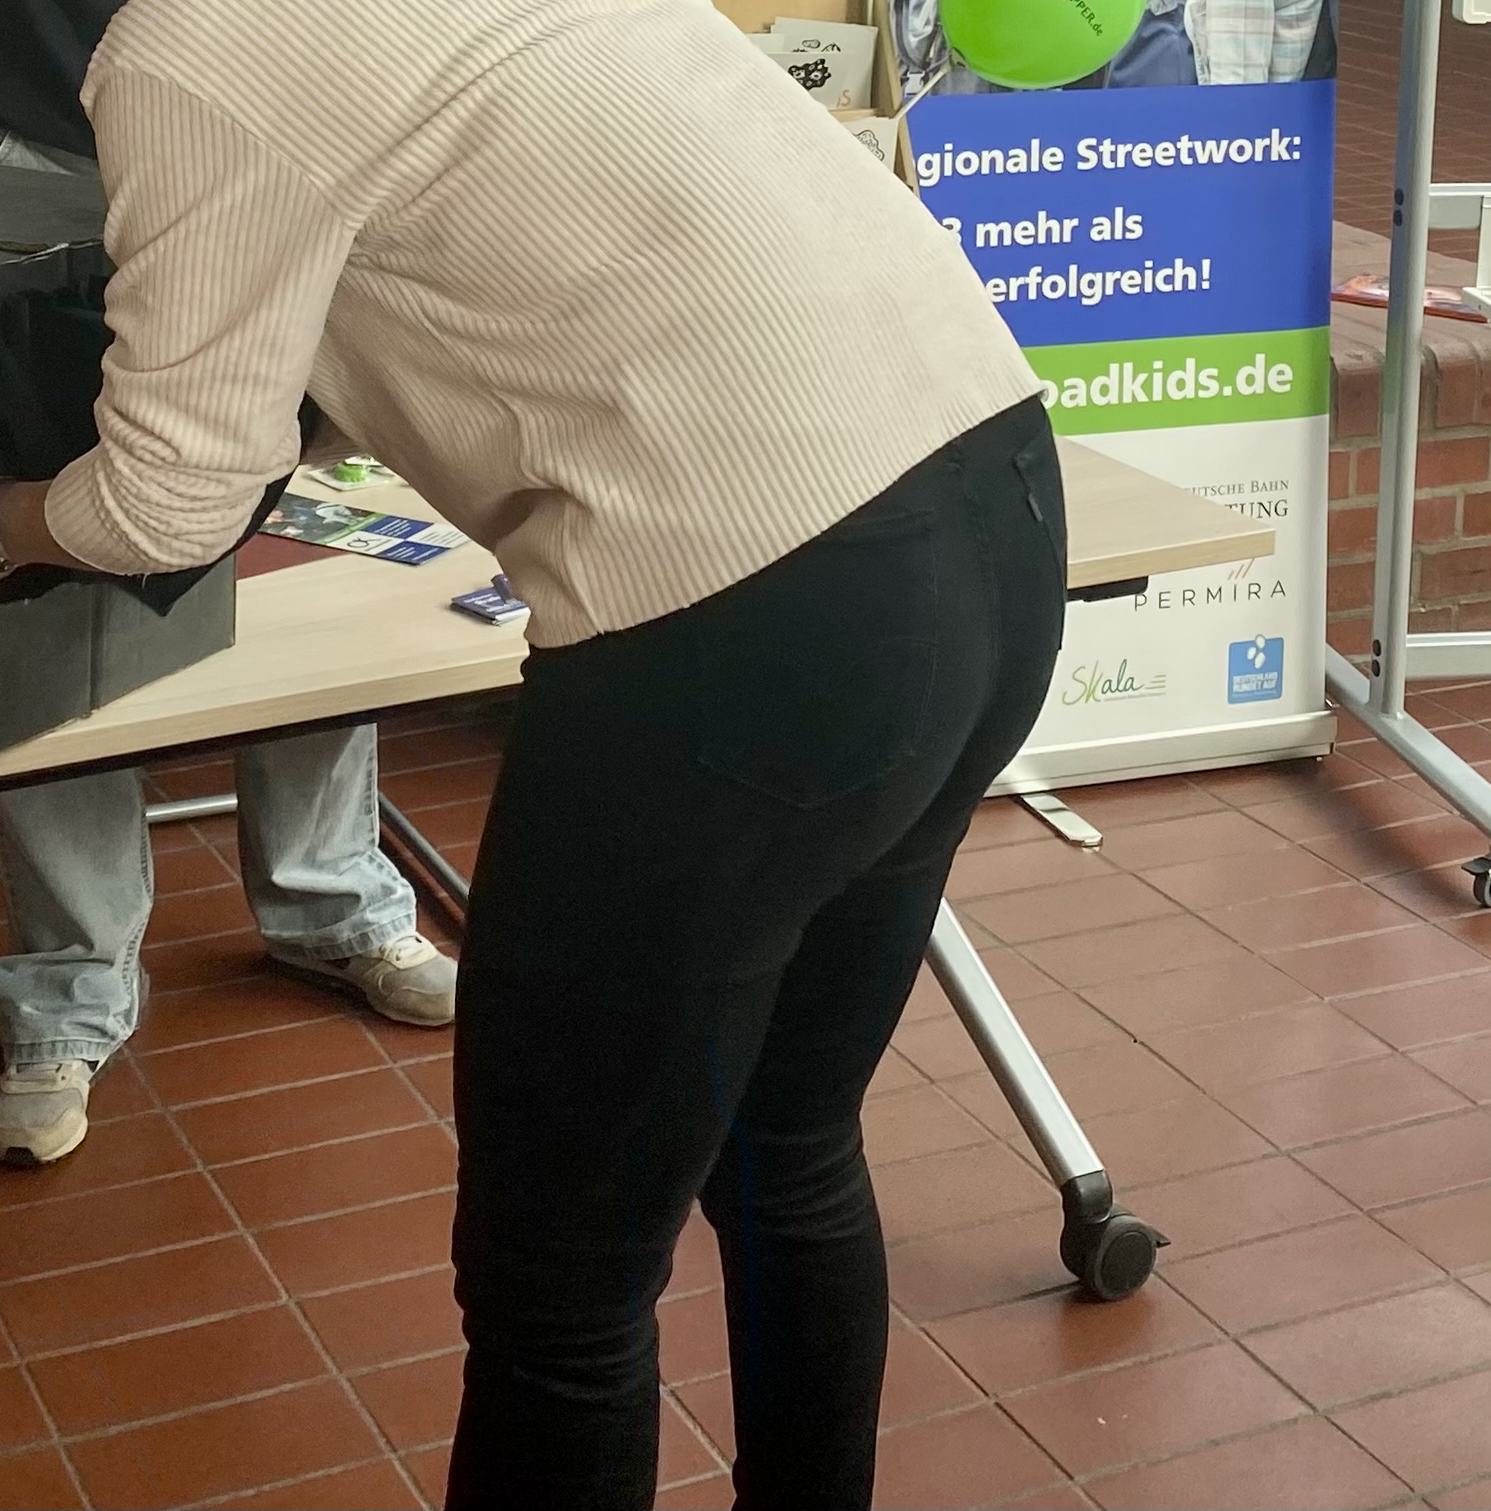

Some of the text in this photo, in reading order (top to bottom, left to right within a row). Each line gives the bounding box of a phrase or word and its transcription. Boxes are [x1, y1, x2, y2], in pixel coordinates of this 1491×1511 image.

[914, 128, 1301, 186] gionale Streetwork:
[976, 211, 1078, 247] mehr
[1090, 207, 1143, 241] als
[985, 258, 1211, 305] erfolgreich!
[1134, 580, 1286, 611] PERMIRA
